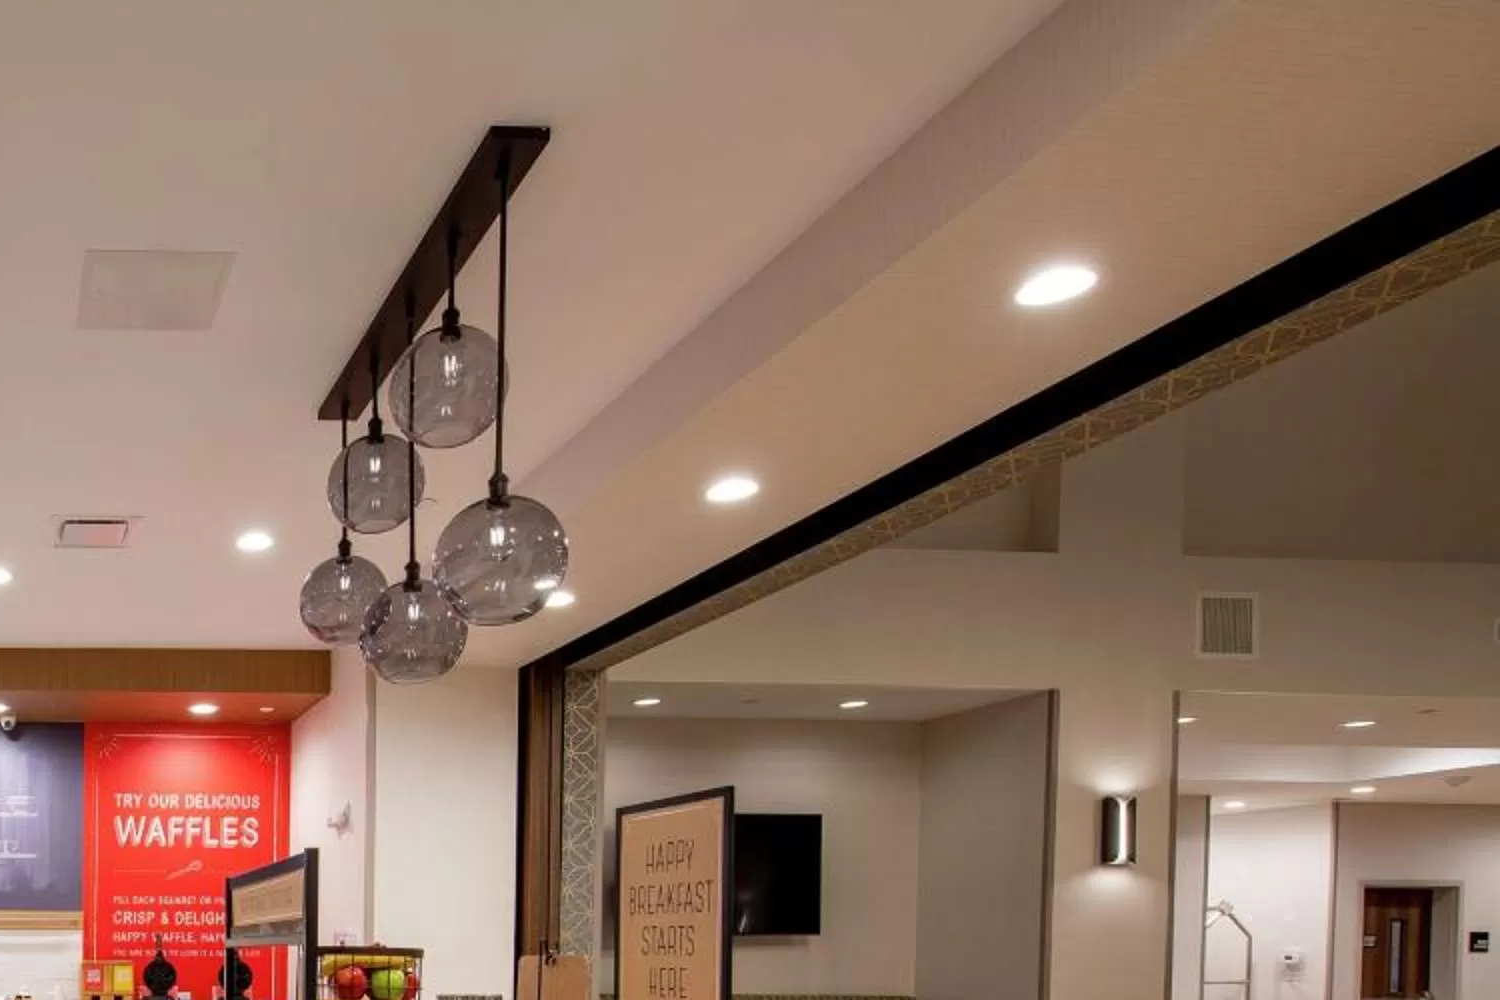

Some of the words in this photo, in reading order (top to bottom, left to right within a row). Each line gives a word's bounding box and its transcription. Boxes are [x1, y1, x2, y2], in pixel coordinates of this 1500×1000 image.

[113, 793, 144, 809] TRY
[148, 793, 180, 809] OUR
[185, 794, 260, 810] DELICIOUS
[113, 815, 260, 848] WAFFLES
[645, 839, 695, 874] HAPPY
[629, 880, 714, 917] BREAKFAST
[112, 910, 155, 926] CRISP
[161, 911, 169, 925] &
[175, 911, 226, 926] DELIGH
[112, 931, 148, 943] HAPPY
[641, 925, 695, 957] STARTS
[648, 967, 688, 999] HERE
